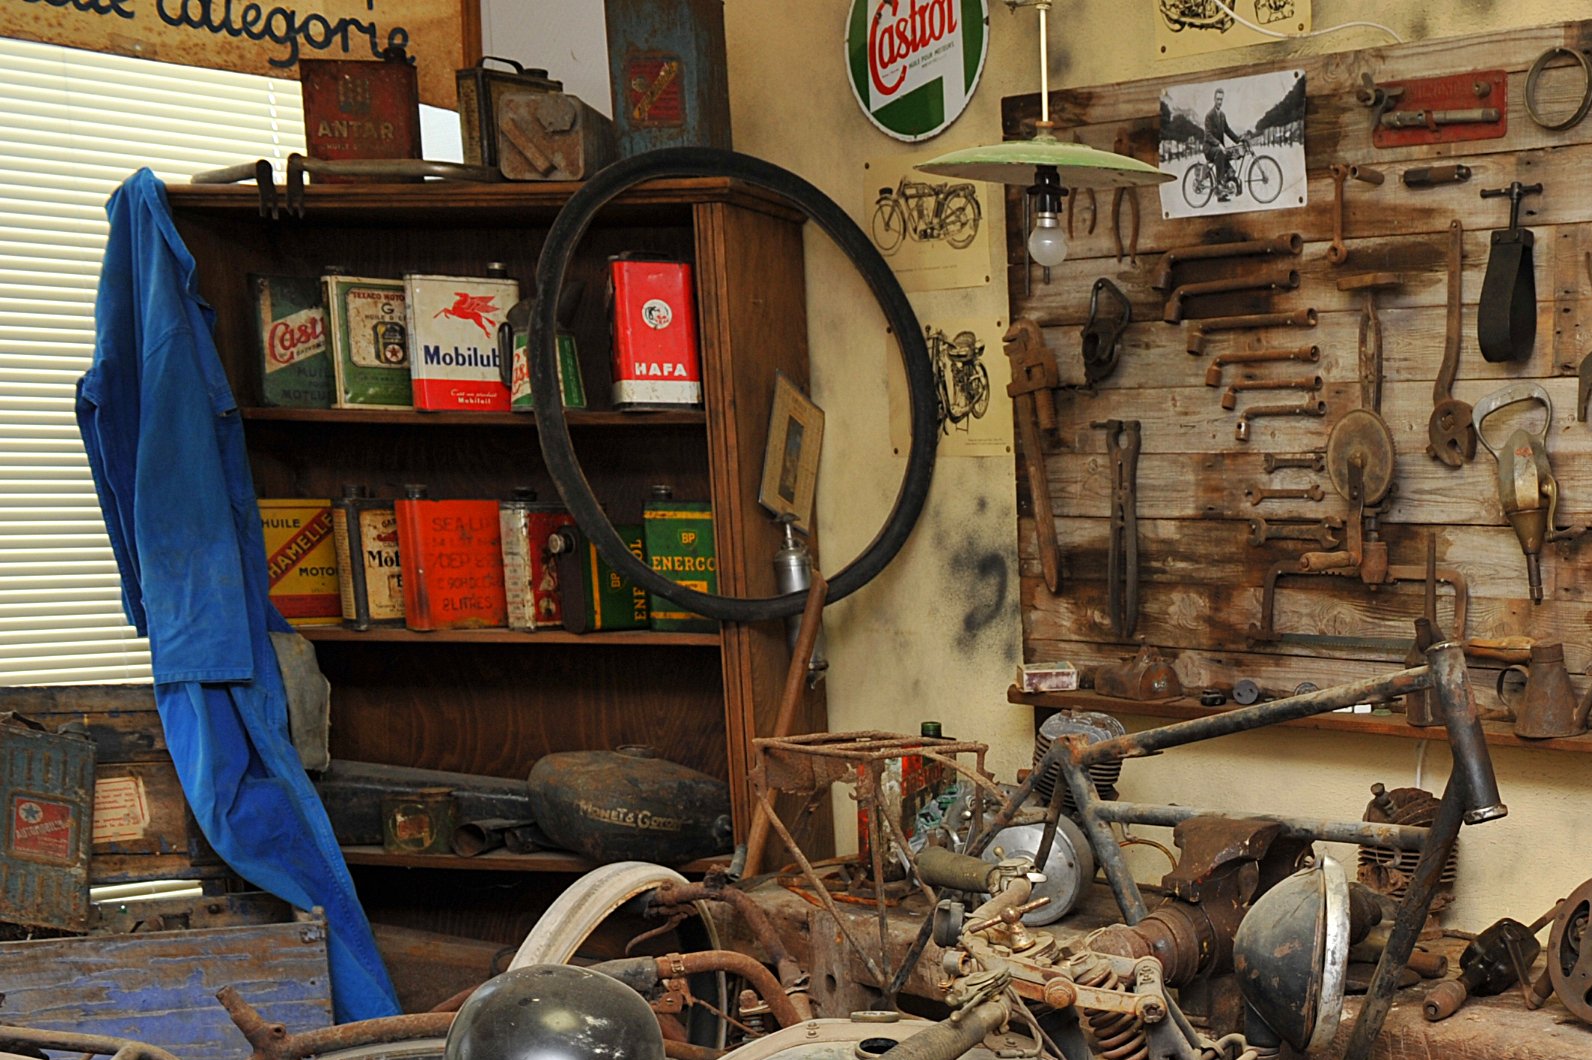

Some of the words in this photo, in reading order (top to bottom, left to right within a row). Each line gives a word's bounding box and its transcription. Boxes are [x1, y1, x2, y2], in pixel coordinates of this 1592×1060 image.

[869, 0, 957, 96] Castrol
[317, 119, 394, 140] ANTAR
[351, 291, 382, 301] TEXACO
[381, 303, 394, 315] G
[635, 362, 687, 377] HAFA
[269, 512, 333, 579] HAMELLE
[681, 532, 696, 545] BP
